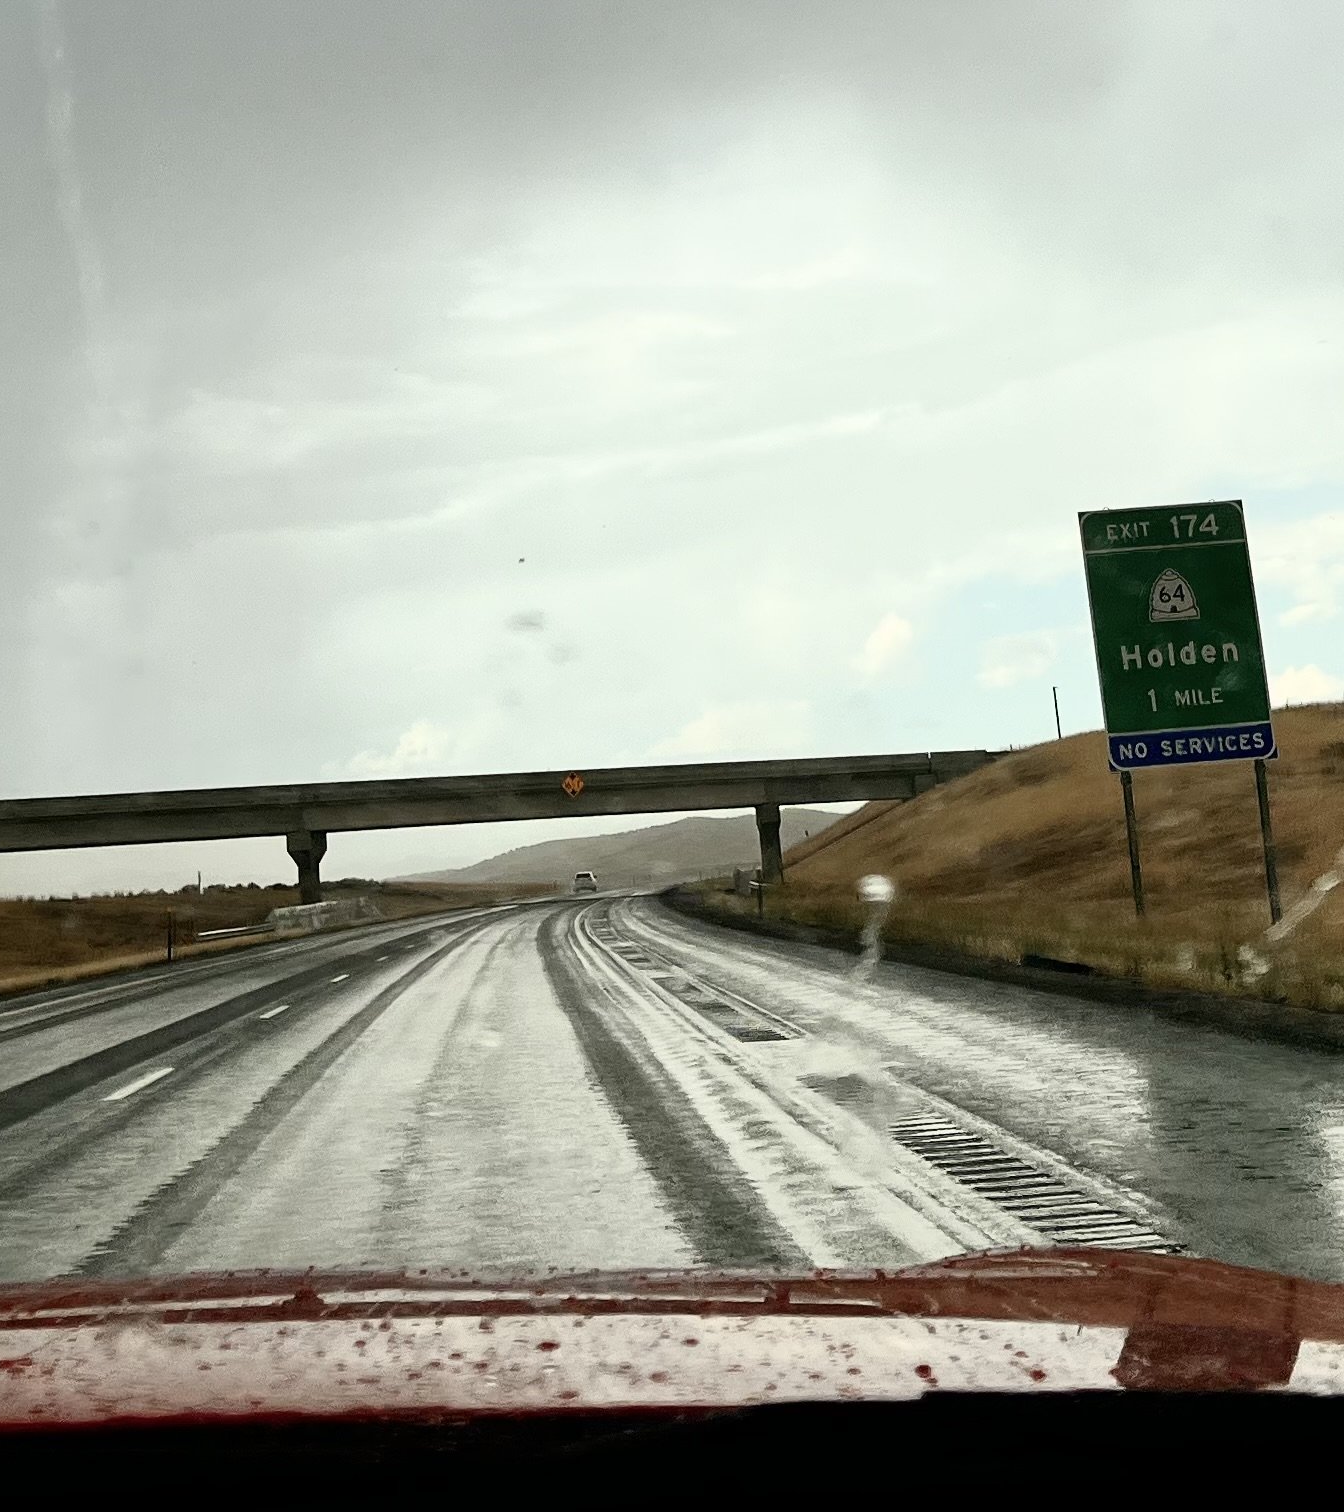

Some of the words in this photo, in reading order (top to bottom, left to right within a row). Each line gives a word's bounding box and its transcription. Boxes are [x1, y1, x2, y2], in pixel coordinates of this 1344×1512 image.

[1106, 520, 1150, 541] EXIT
[1169, 513, 1219, 538] 174
[1158, 583, 1186, 603] 64
[1120, 641, 1239, 670] Holden
[1147, 688, 1158, 712] 1
[1174, 687, 1224, 707] MILE
[1118, 742, 1147, 761] NO
[1159, 732, 1265, 756] SERVICES
